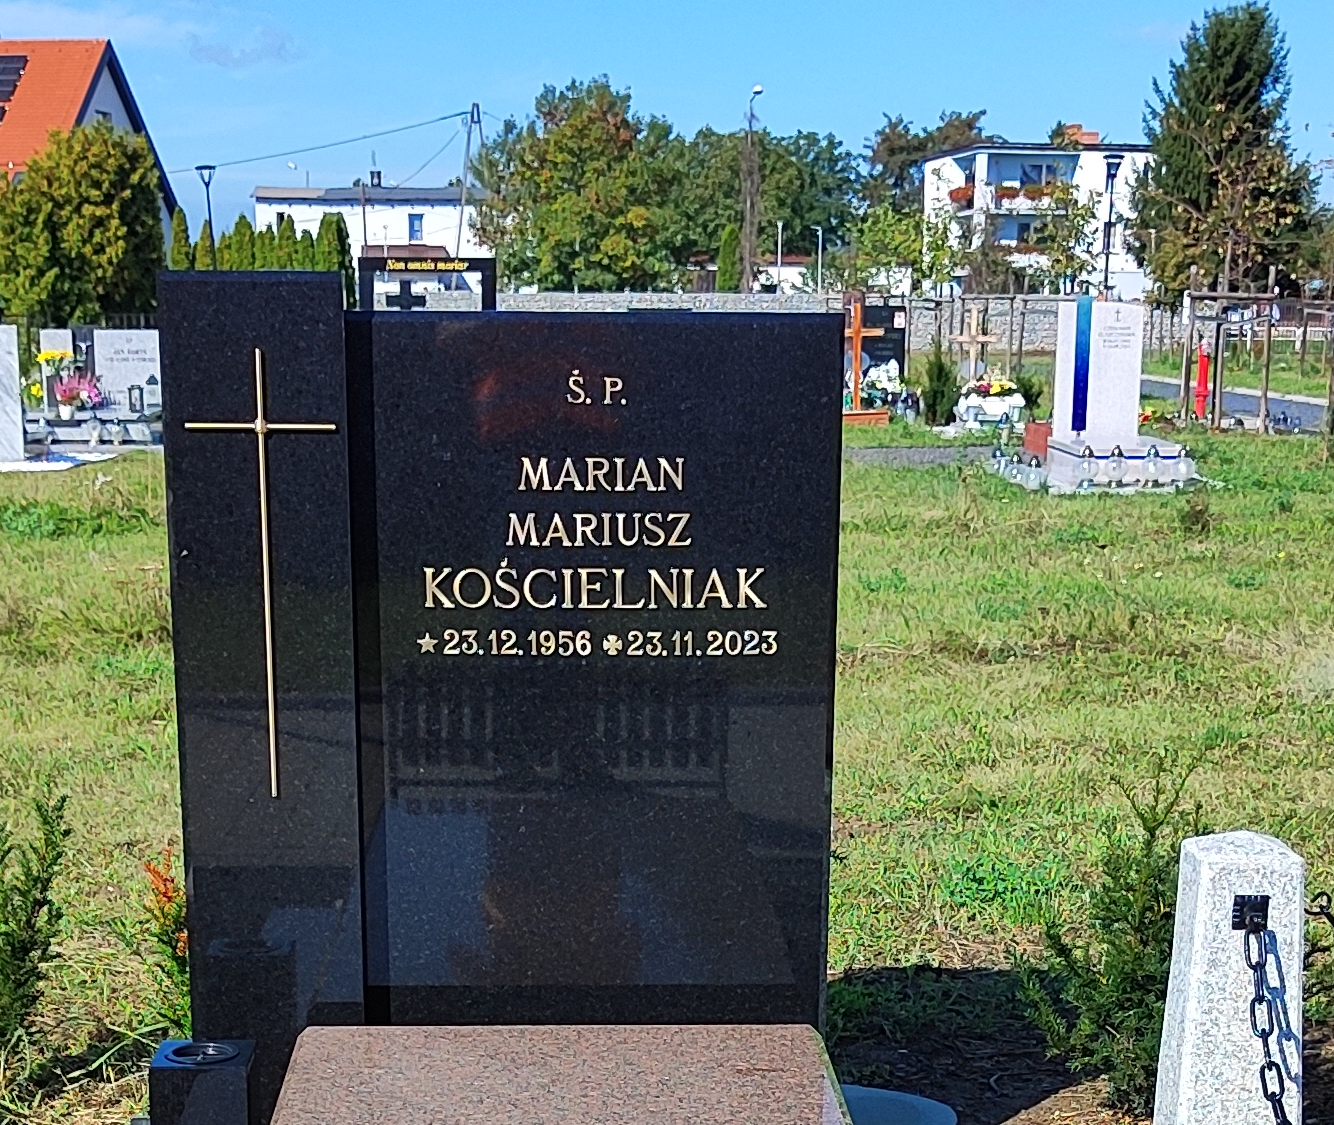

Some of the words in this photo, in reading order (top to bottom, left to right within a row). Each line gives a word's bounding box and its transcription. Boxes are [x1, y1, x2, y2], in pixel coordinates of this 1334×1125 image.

[602, 376, 627, 406] P.
[517, 457, 685, 491] MARIAN
[505, 512, 692, 547] MARIUSZ
[423, 557, 767, 609] KOŚCIELNIAK
[442, 629, 592, 656] 23.12.1956
[626, 630, 778, 657] 23.11.2023
